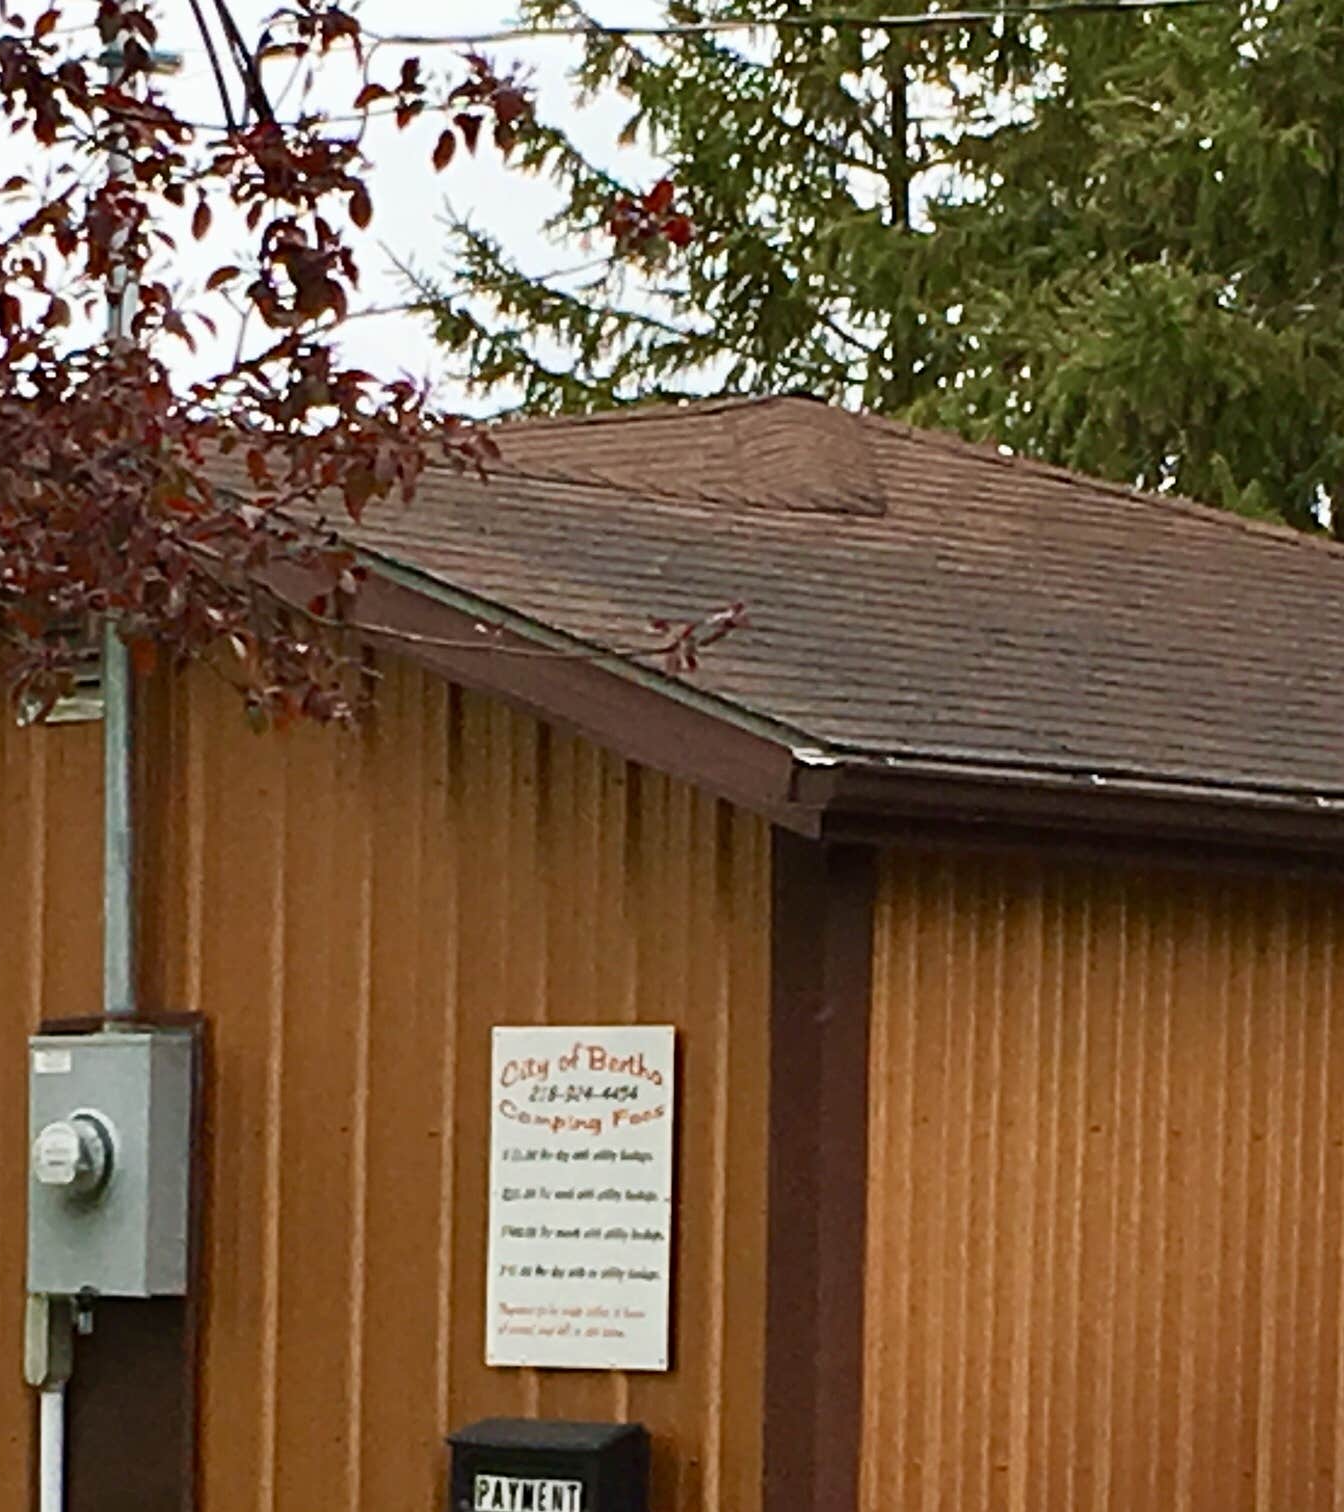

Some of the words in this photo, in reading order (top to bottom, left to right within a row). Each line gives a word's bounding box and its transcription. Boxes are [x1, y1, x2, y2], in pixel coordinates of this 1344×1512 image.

[500, 1058, 549, 1087] City
[558, 1042, 582, 1072] of
[586, 1044, 663, 1086] Bertha
[499, 1098, 602, 1136] Camping
[612, 1104, 665, 1128] Fees
